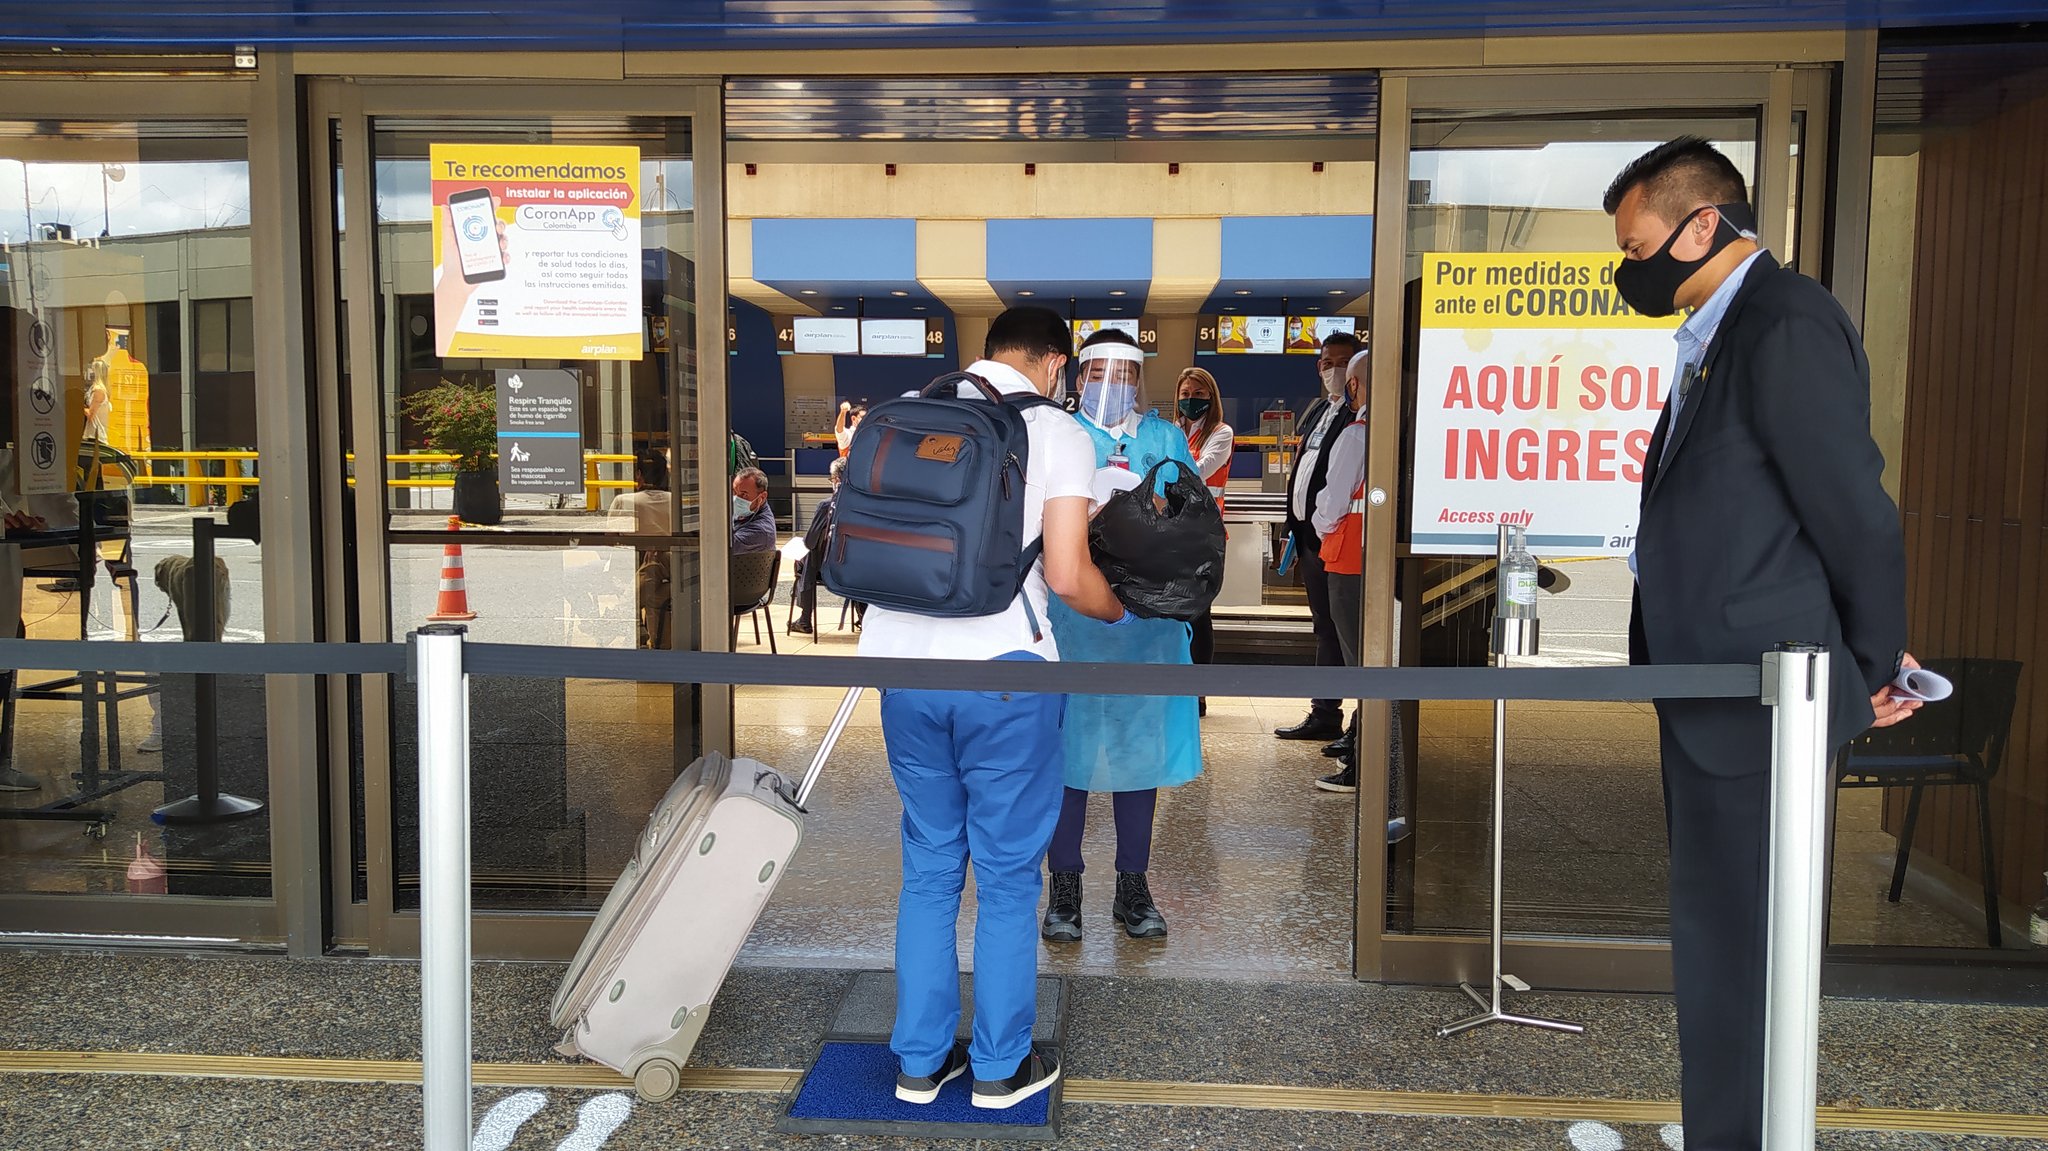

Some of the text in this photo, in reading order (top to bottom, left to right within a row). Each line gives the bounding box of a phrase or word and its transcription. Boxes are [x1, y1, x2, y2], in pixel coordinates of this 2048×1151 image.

[444, 161, 626, 179] Te recomendamos
[506, 187, 627, 200] instalar la aplicación
[524, 207, 595, 222] CoronApp
[581, 250, 628, 258] condiciones
[538, 260, 548, 268] de
[551, 260, 572, 268] salud
[580, 271, 603, 280] seguir
[1436, 261, 1614, 286] Por medidas d
[525, 280, 536, 288] las
[1435, 295, 1476, 313] ante
[1484, 295, 1500, 313] el
[779, 328, 794, 342] 47
[926, 331, 943, 344] 48
[1140, 330, 1156, 343] 50
[1200, 327, 1215, 340] 51
[1355, 330, 1369, 343] 52
[581, 339, 617, 356] airplan
[1443, 354, 1670, 416] AQUÍ SOL
[509, 396, 572, 406] Respire Tranquilo
[1444, 428, 1653, 483] INGRES
[1438, 508, 1534, 526] Access only
[1609, 525, 1635, 548] air
